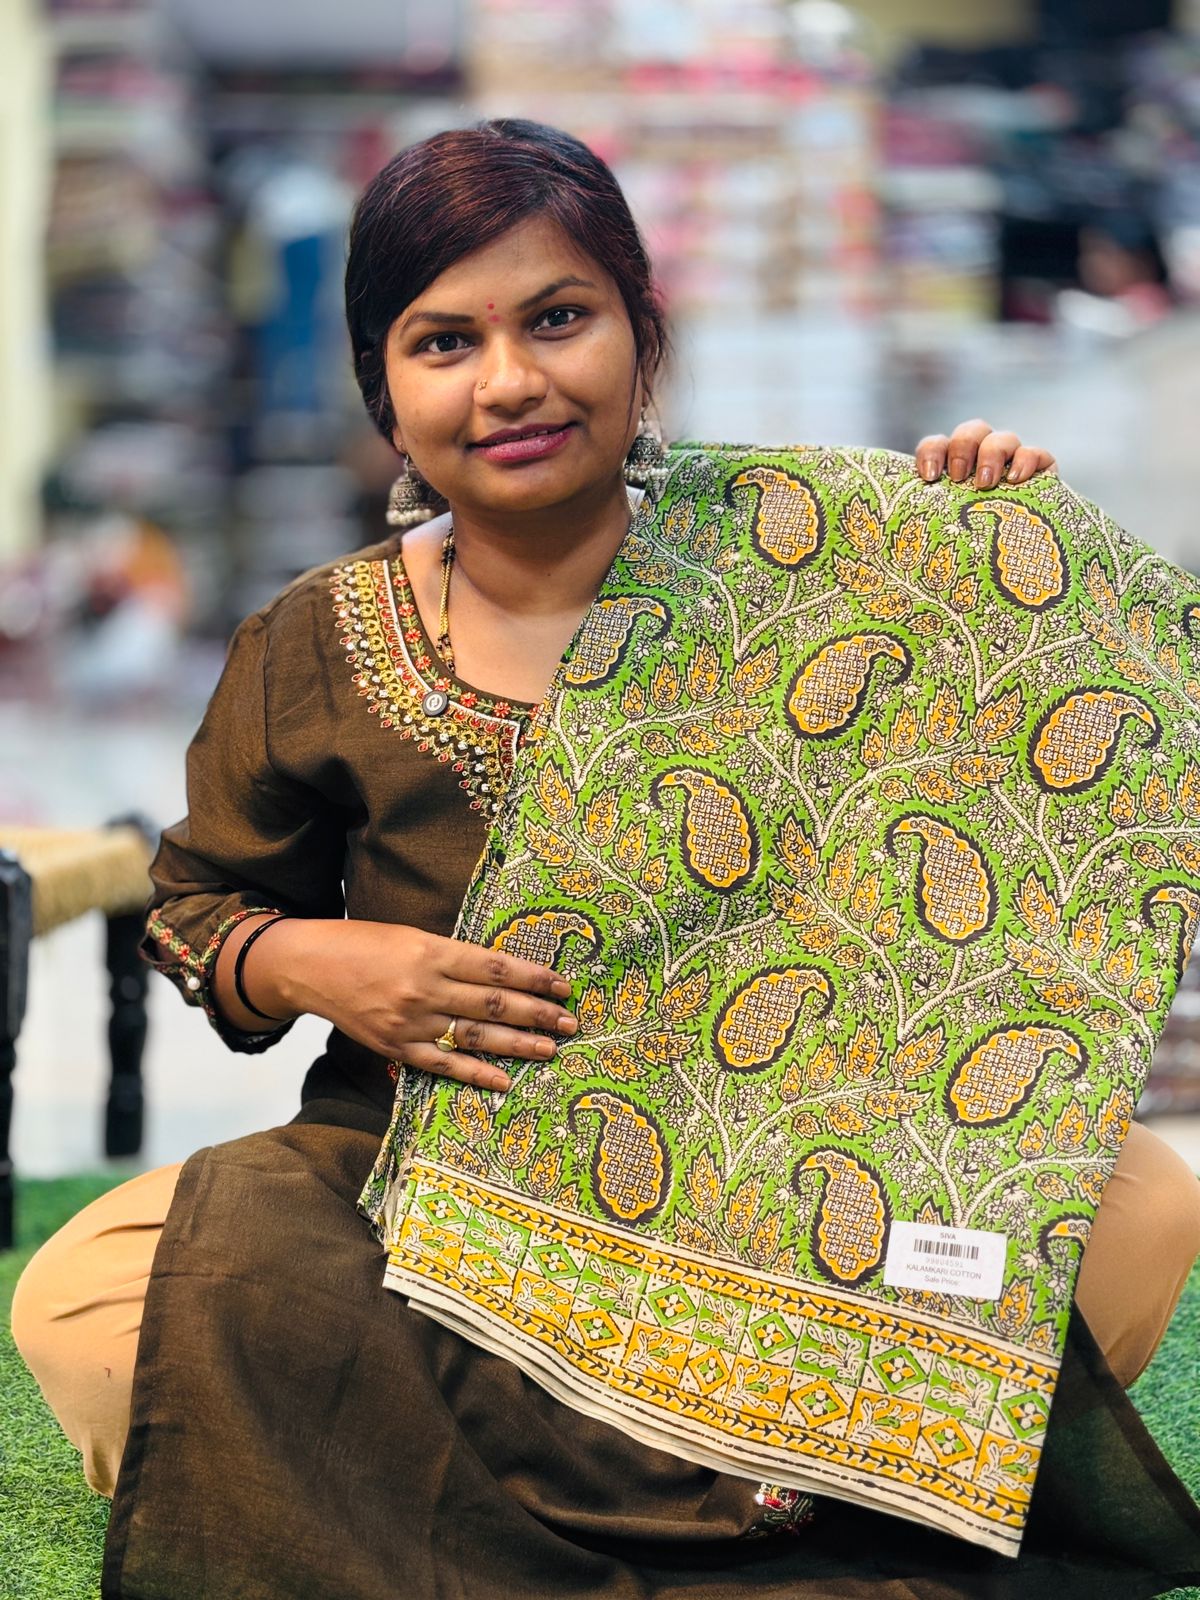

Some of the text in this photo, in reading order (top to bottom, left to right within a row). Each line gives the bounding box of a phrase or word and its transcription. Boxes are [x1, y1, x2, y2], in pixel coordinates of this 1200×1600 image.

[940, 1232, 956, 1240] SIVA
[906, 1264, 982, 1279] KALAMKARI COTTON
[924, 1275, 940, 1283] Sale
